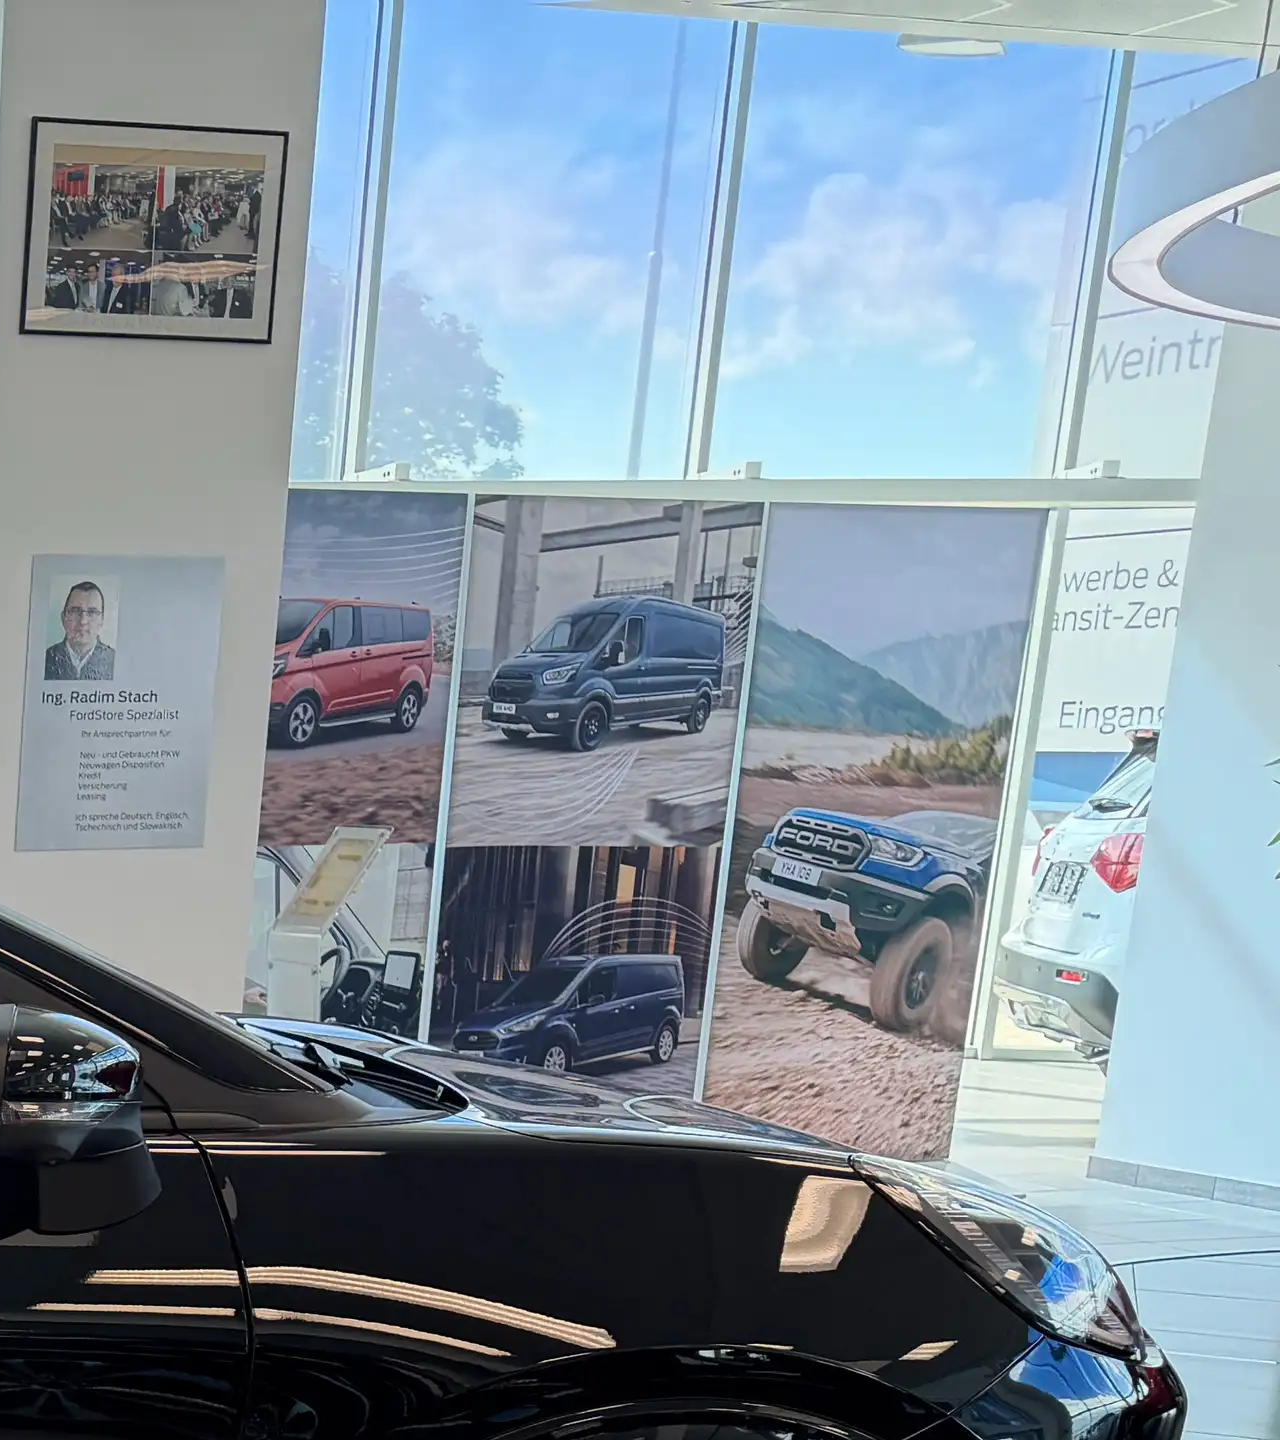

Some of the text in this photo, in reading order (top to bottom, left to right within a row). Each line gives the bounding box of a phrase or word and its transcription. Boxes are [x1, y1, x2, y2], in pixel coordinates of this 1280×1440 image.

[1063, 559, 1180, 593] werbe &
[41, 690, 158, 706] Ing. Radim Stach
[69, 708, 179, 722] FordStore Spezialist
[1059, 700, 1165, 735] Eingan
[93, 729, 157, 739] Ansprechpartner
[79, 751, 96, 759] Neu
[118, 750, 159, 758] Gebraucht
[160, 750, 180, 758] PKW
[78, 760, 165, 770] Neuwagen Disposition
[77, 782, 128, 791] Versicherung
[76, 793, 107, 801] Leasing
[123, 822, 138, 831] und
[139, 821, 183, 831] Slowakisch
[778, 827, 857, 857] FORD
